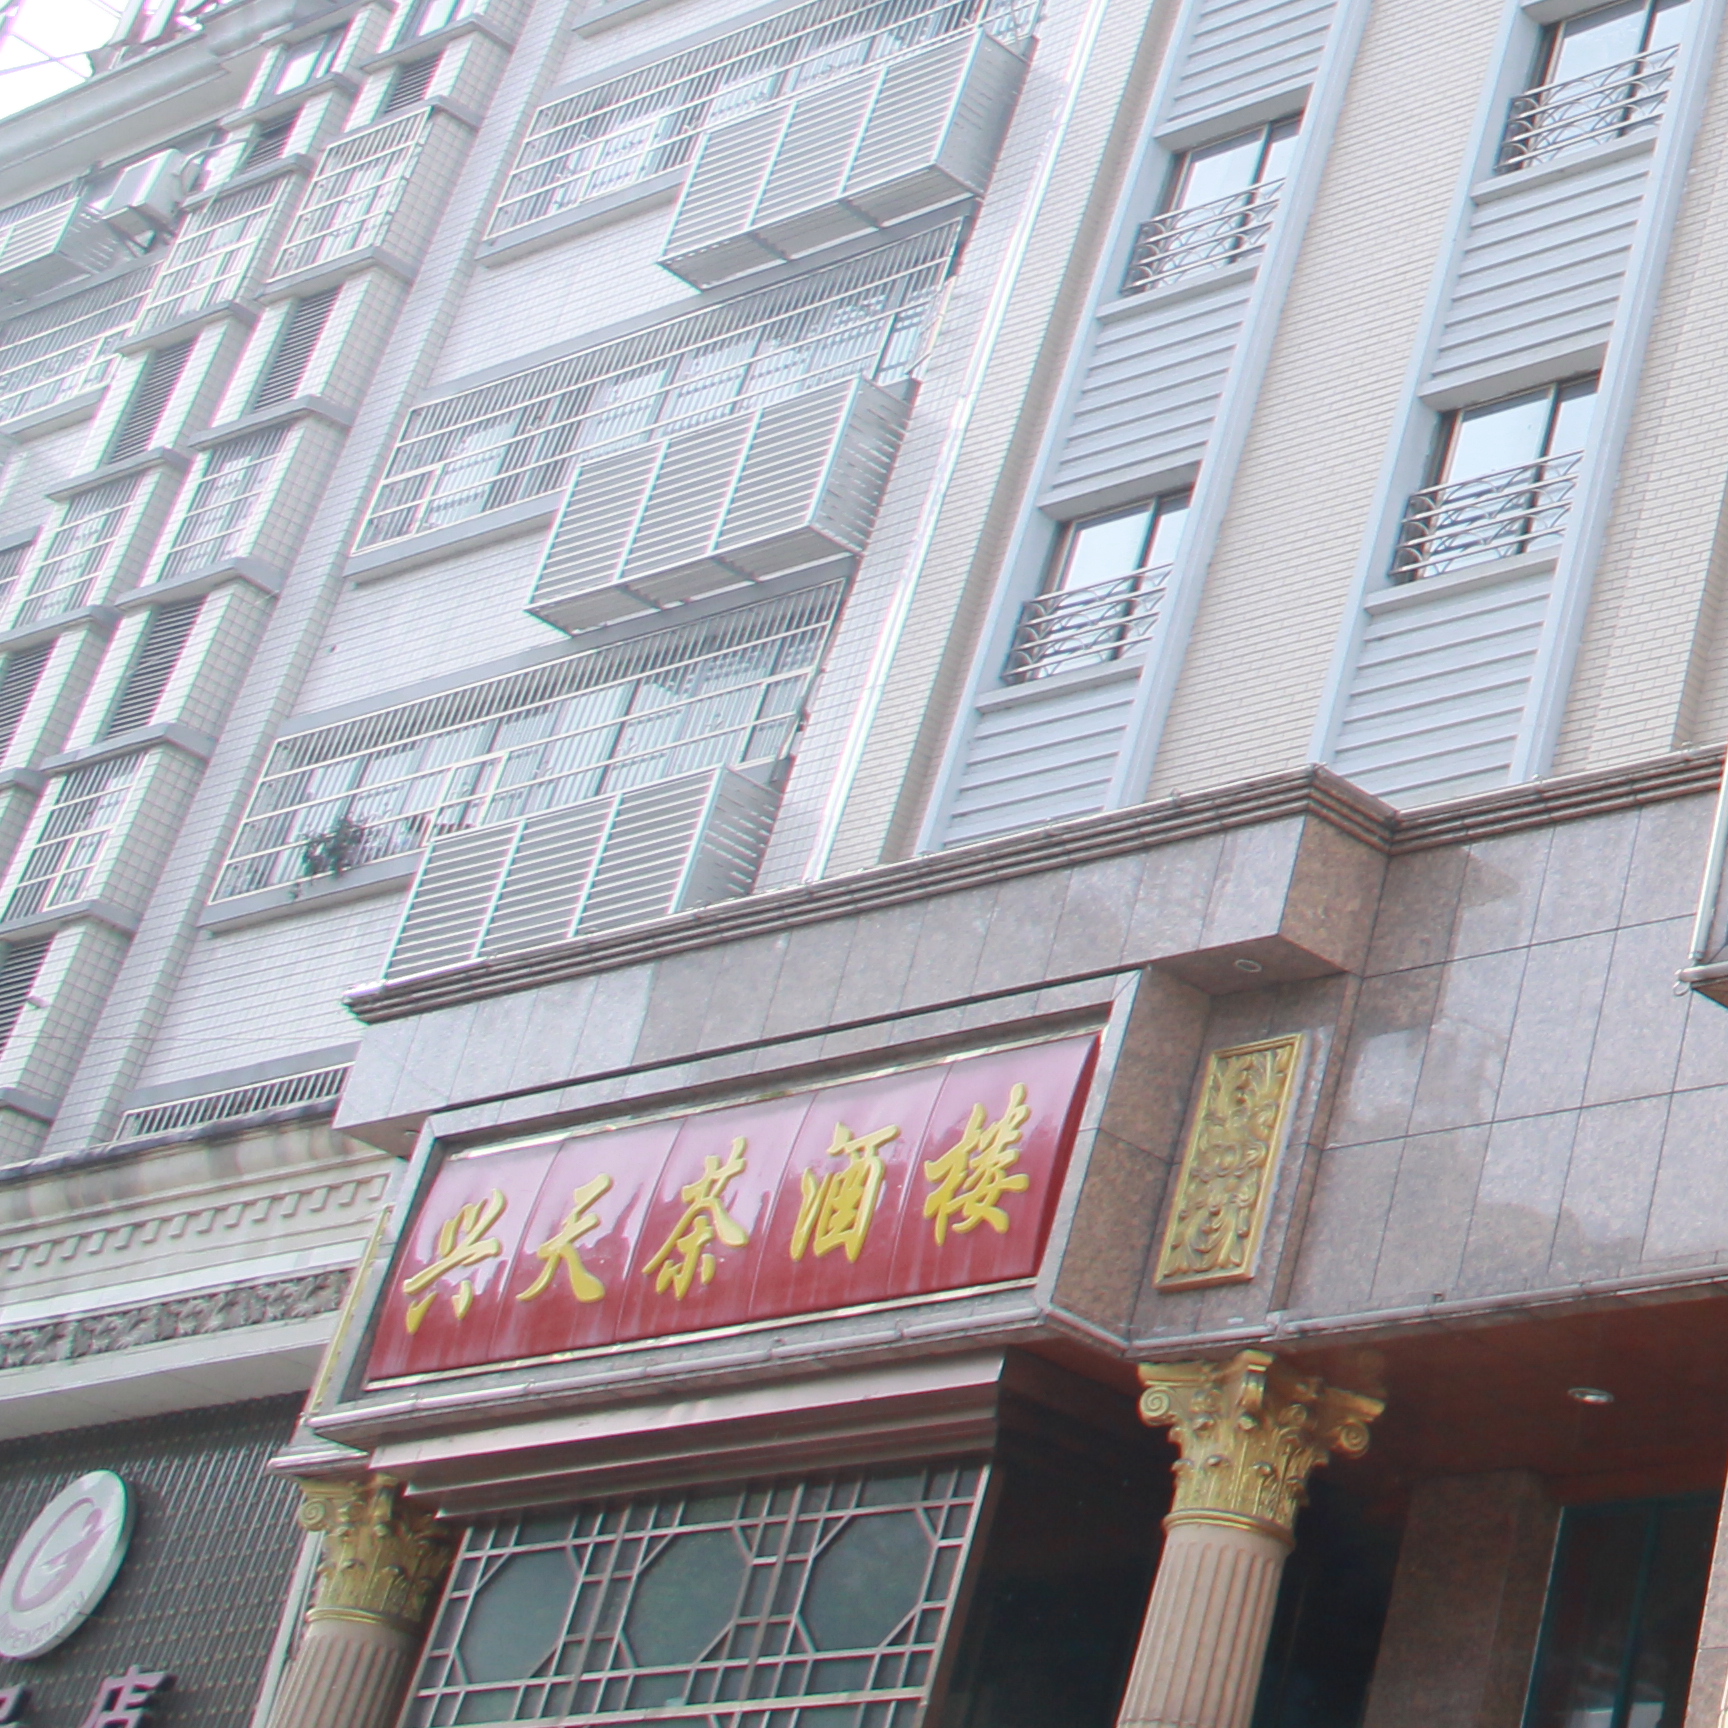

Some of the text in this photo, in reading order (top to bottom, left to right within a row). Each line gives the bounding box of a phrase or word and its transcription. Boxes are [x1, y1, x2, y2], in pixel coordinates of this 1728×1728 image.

[402, 1083, 1030, 1334] 兴天茶酒楼
